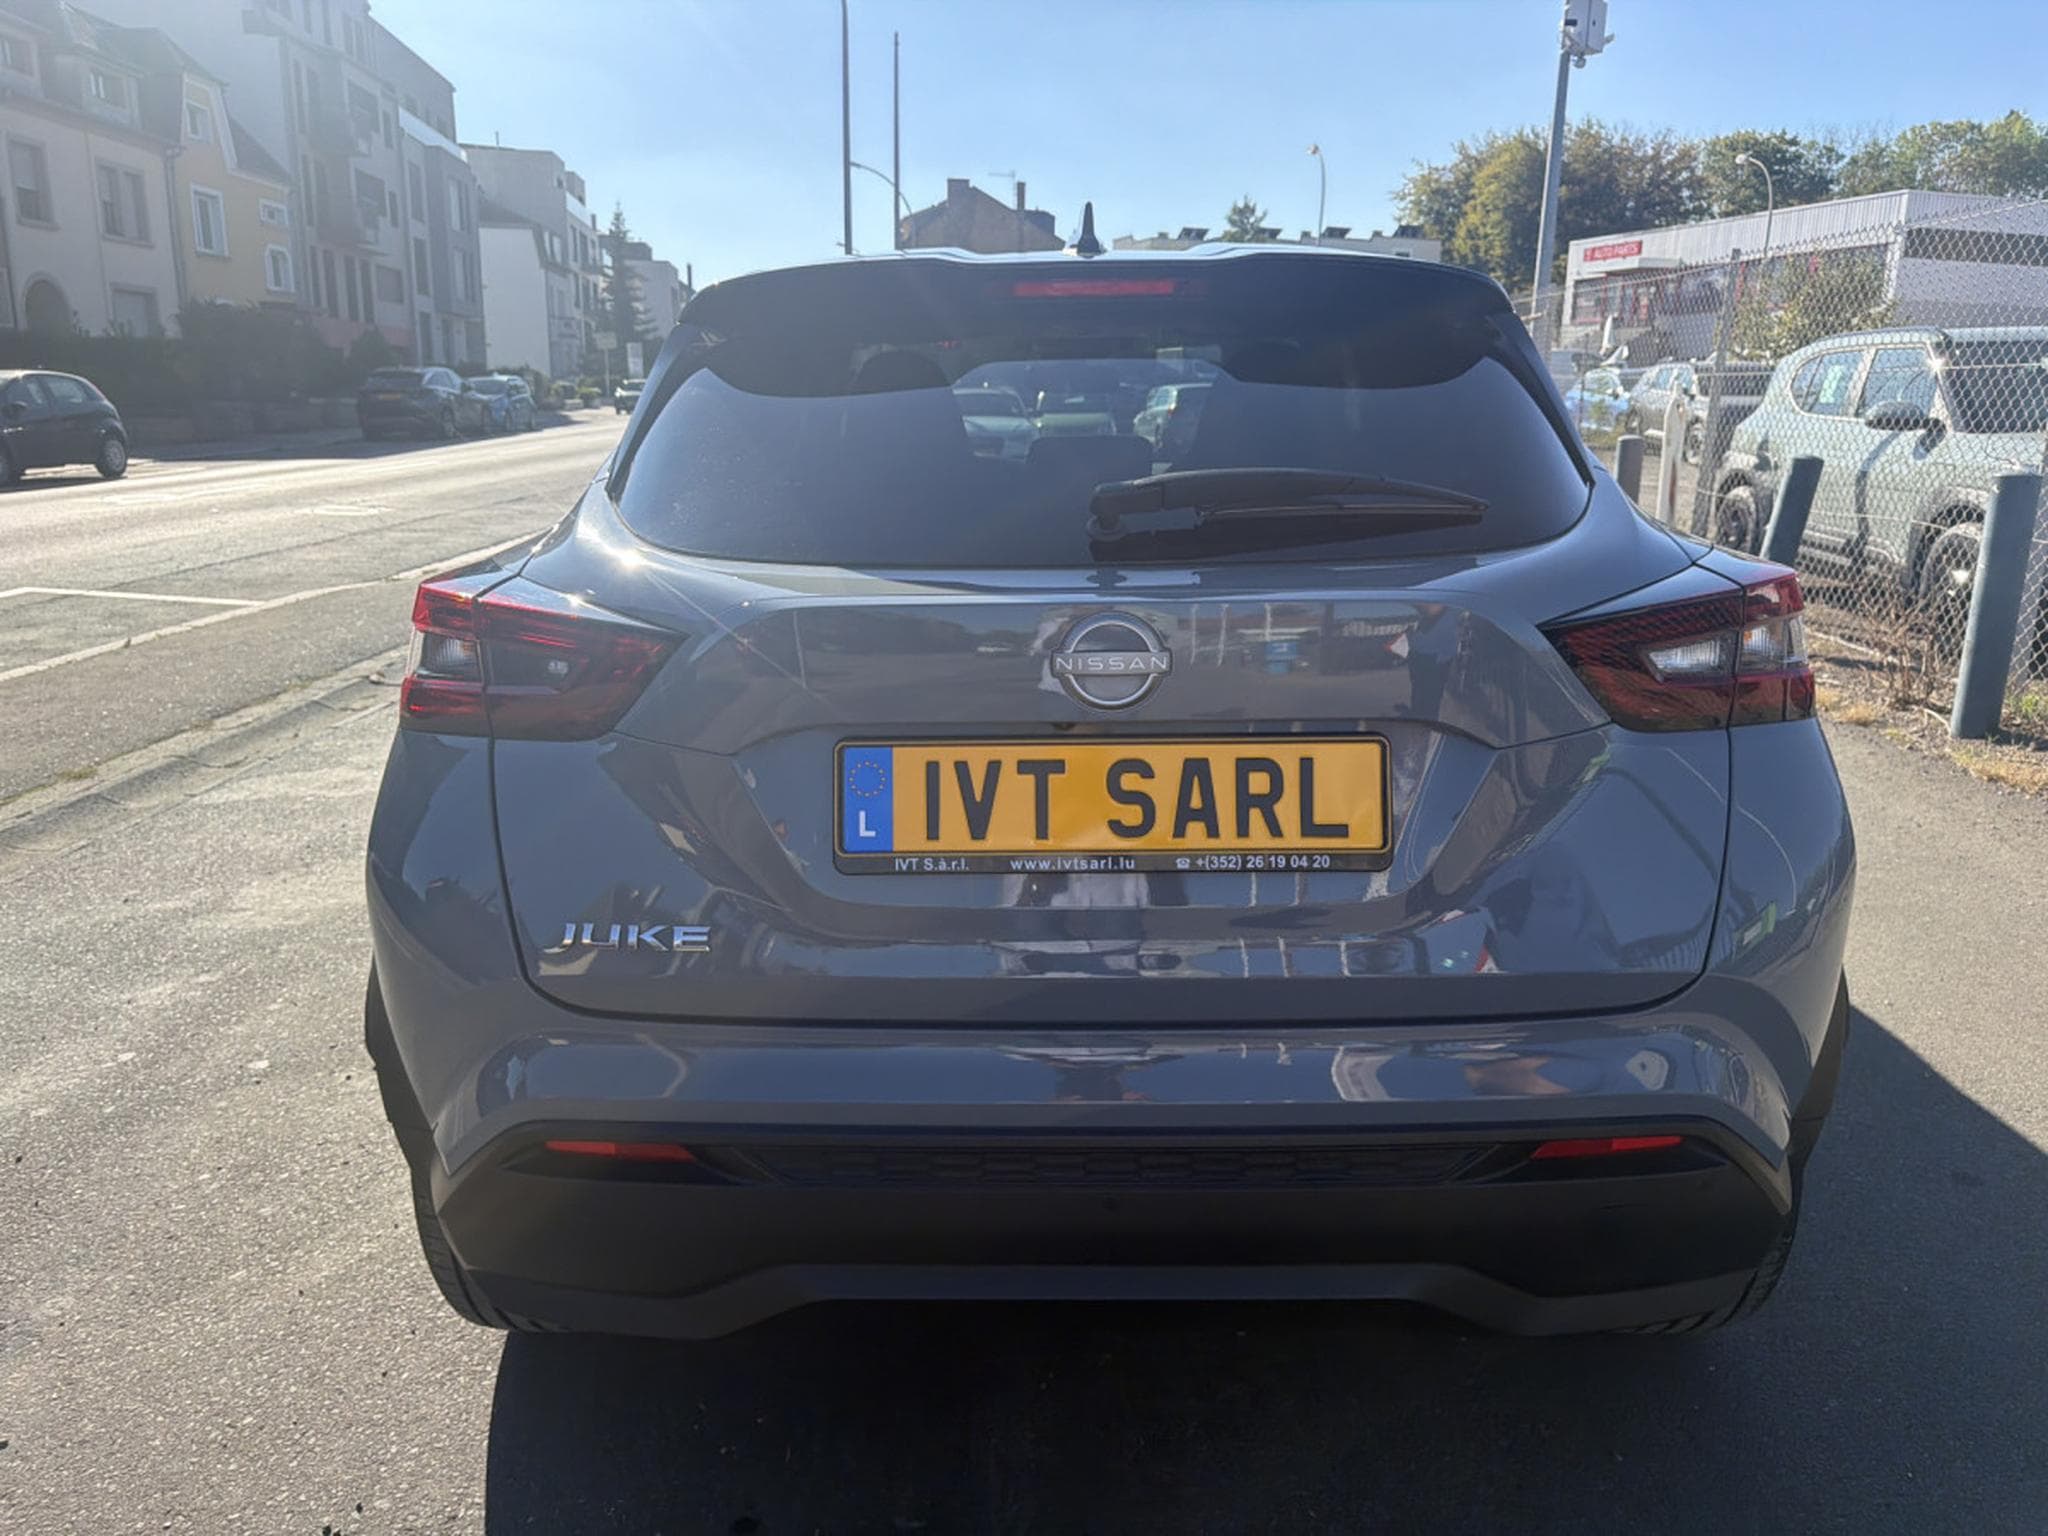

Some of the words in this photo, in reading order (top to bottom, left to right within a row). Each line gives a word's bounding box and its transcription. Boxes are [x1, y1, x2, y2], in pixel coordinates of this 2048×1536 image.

[1056, 656, 1167, 671] NISSAN
[926, 760, 1065, 840] IVT
[1106, 757, 1349, 839] SARL
[859, 810, 876, 837] L
[895, 858, 919, 871] IVT
[1010, 856, 1135, 870] www.ivtsarl.lu
[1196, 855, 1242, 870] +(352)
[1246, 855, 1264, 868] 26
[1269, 855, 1286, 868] 19
[1290, 855, 1308, 868] 04
[1312, 855, 1330, 868] 20
[560, 922, 710, 952] JUKE
